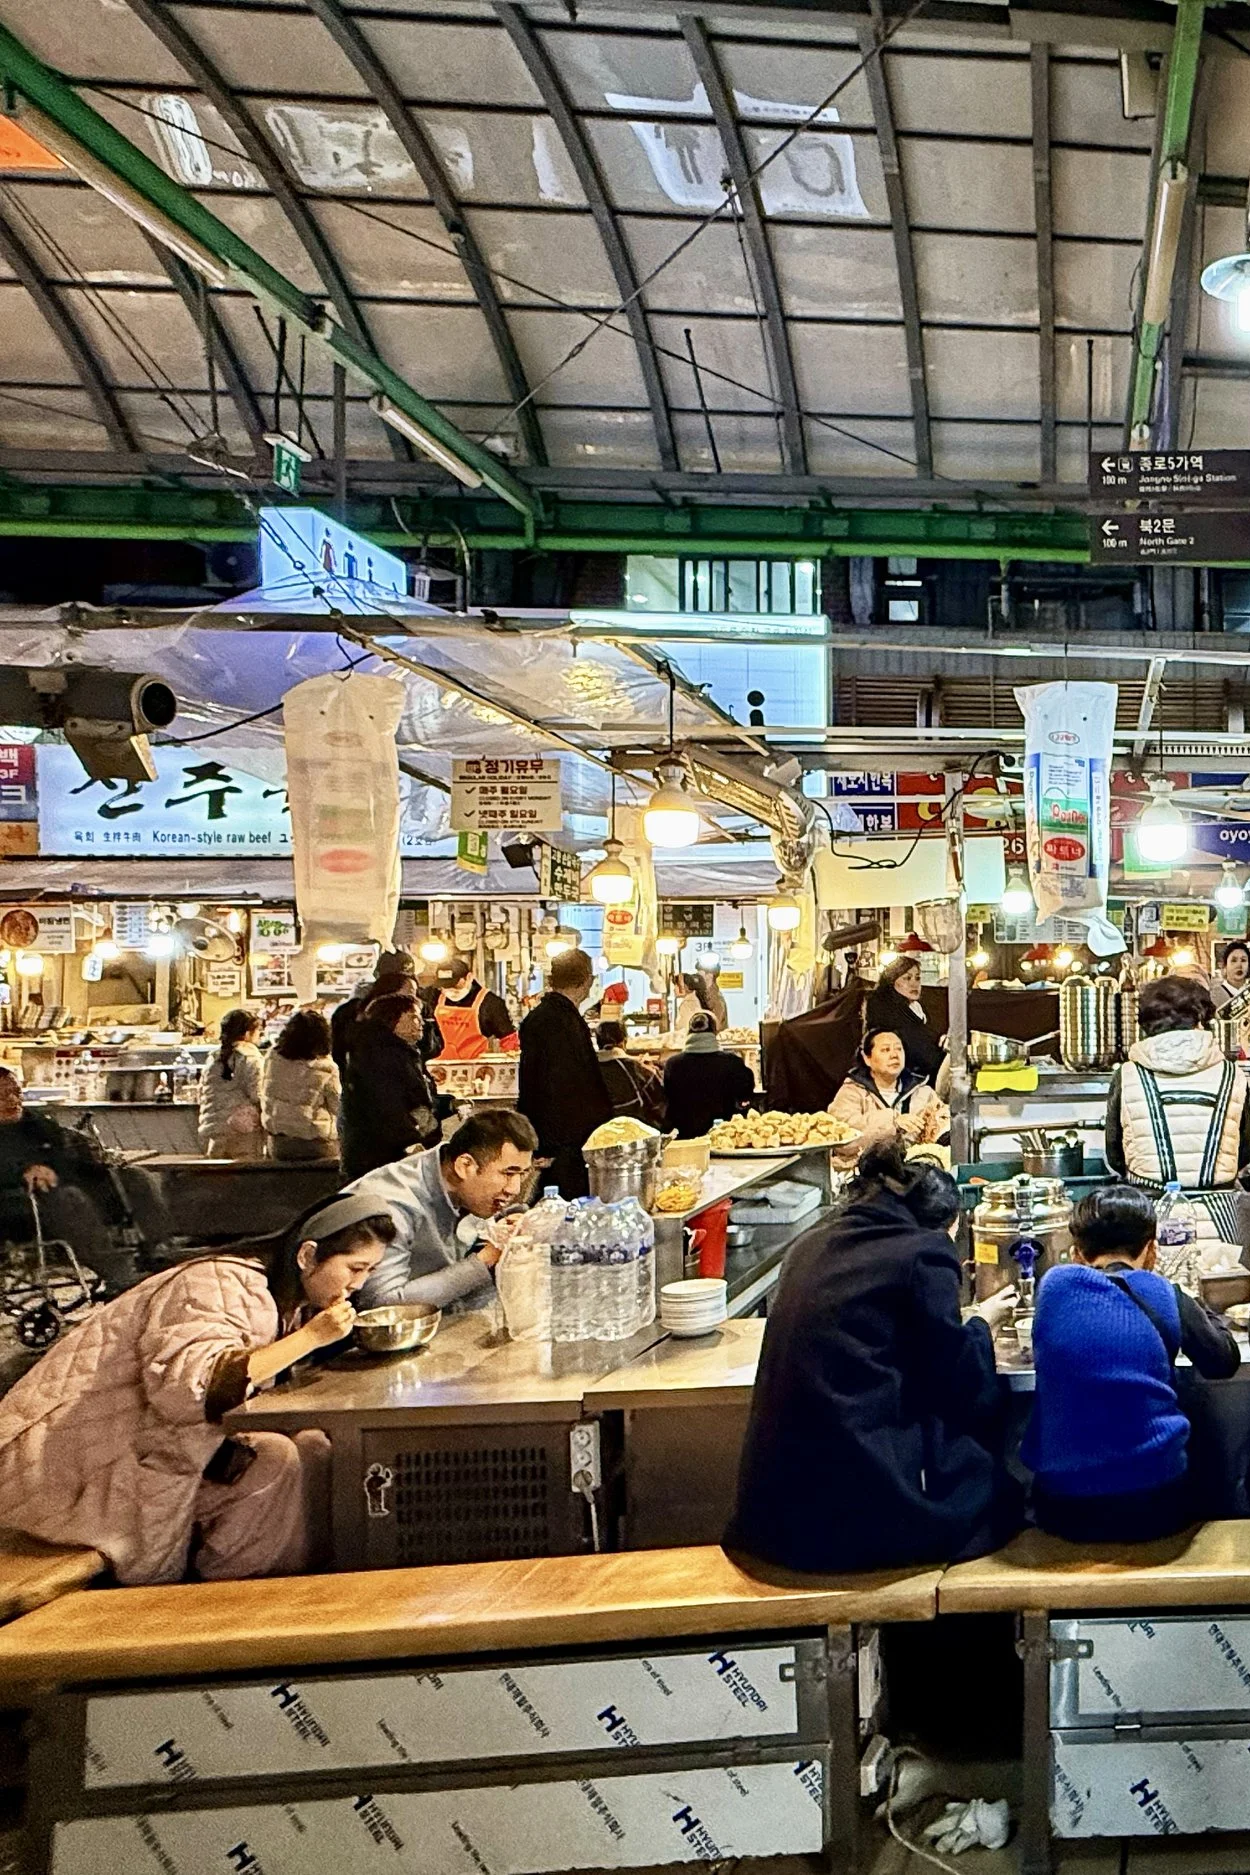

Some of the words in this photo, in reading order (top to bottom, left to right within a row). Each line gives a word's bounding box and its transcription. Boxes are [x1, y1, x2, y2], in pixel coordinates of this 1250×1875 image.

[1139, 455, 1204, 472] 종로5가역
[1205, 473, 1237, 483] Station
[1139, 518, 1175, 534] 북2문
[1139, 536, 1165, 546] North
[1166, 537, 1187, 546] Gate
[152, 830, 223, 844] Korean-style
[226, 833, 246, 844] raw
[249, 830, 272, 843] beef
[1093, 1666, 1114, 1697] Leading
[722, 1673, 750, 1709] STEEL
[731, 1667, 769, 1713] HYUNDAI
